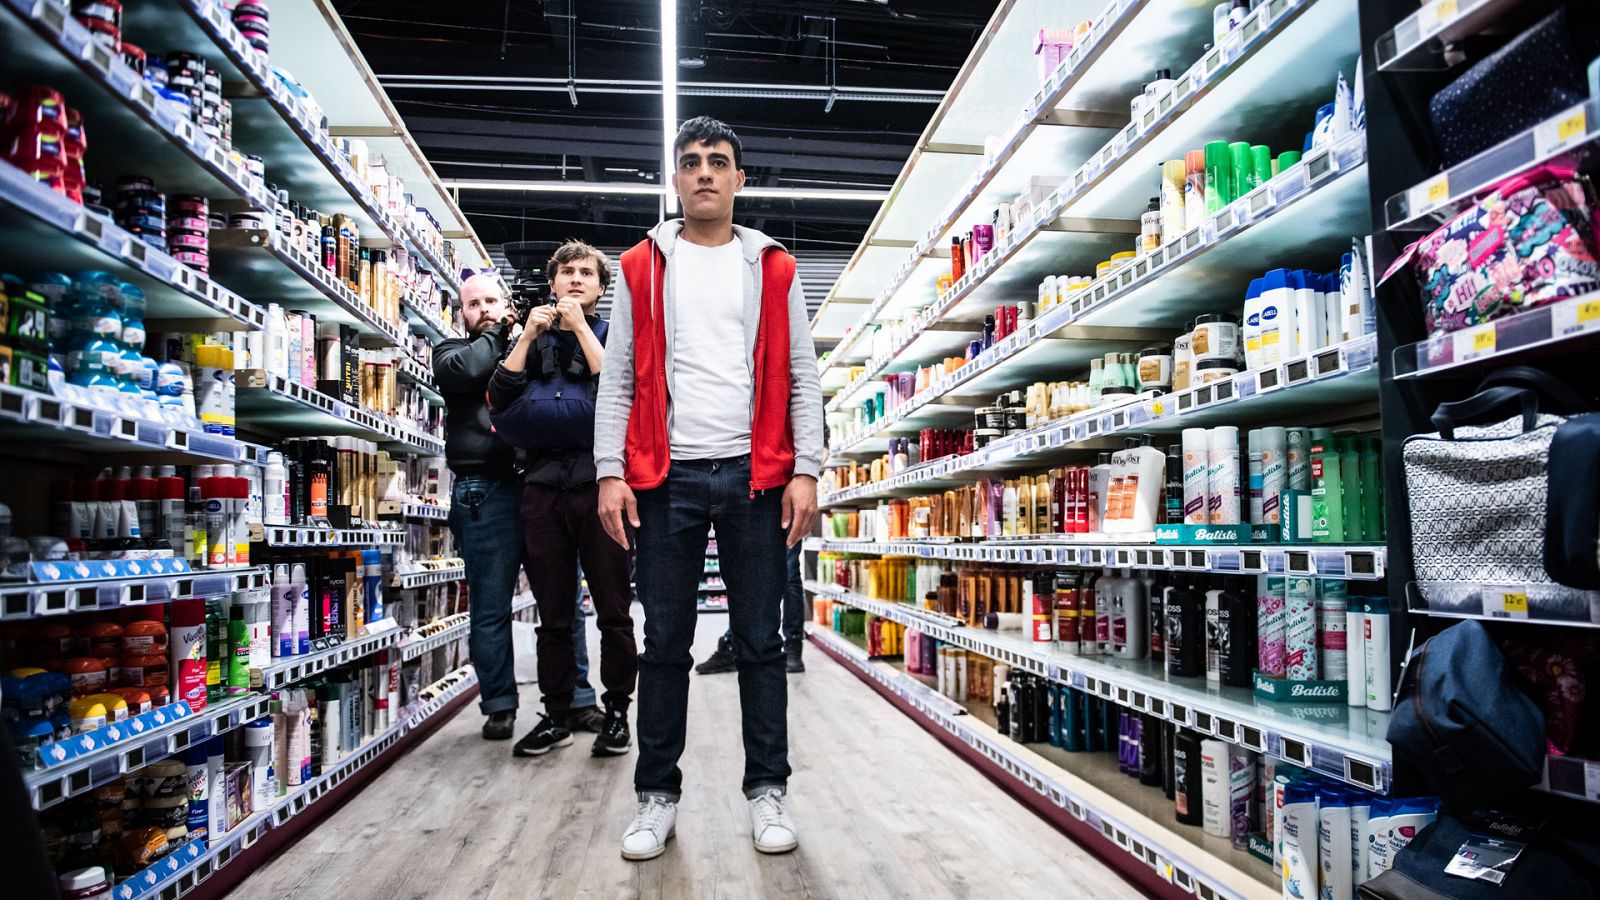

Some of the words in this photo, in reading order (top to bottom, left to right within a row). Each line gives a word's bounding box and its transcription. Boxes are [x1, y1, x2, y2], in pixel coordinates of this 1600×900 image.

[1184, 465, 1206, 481] Batiste
[1195, 528, 1238, 541] Batiste
[1291, 684, 1340, 697] Batiste
